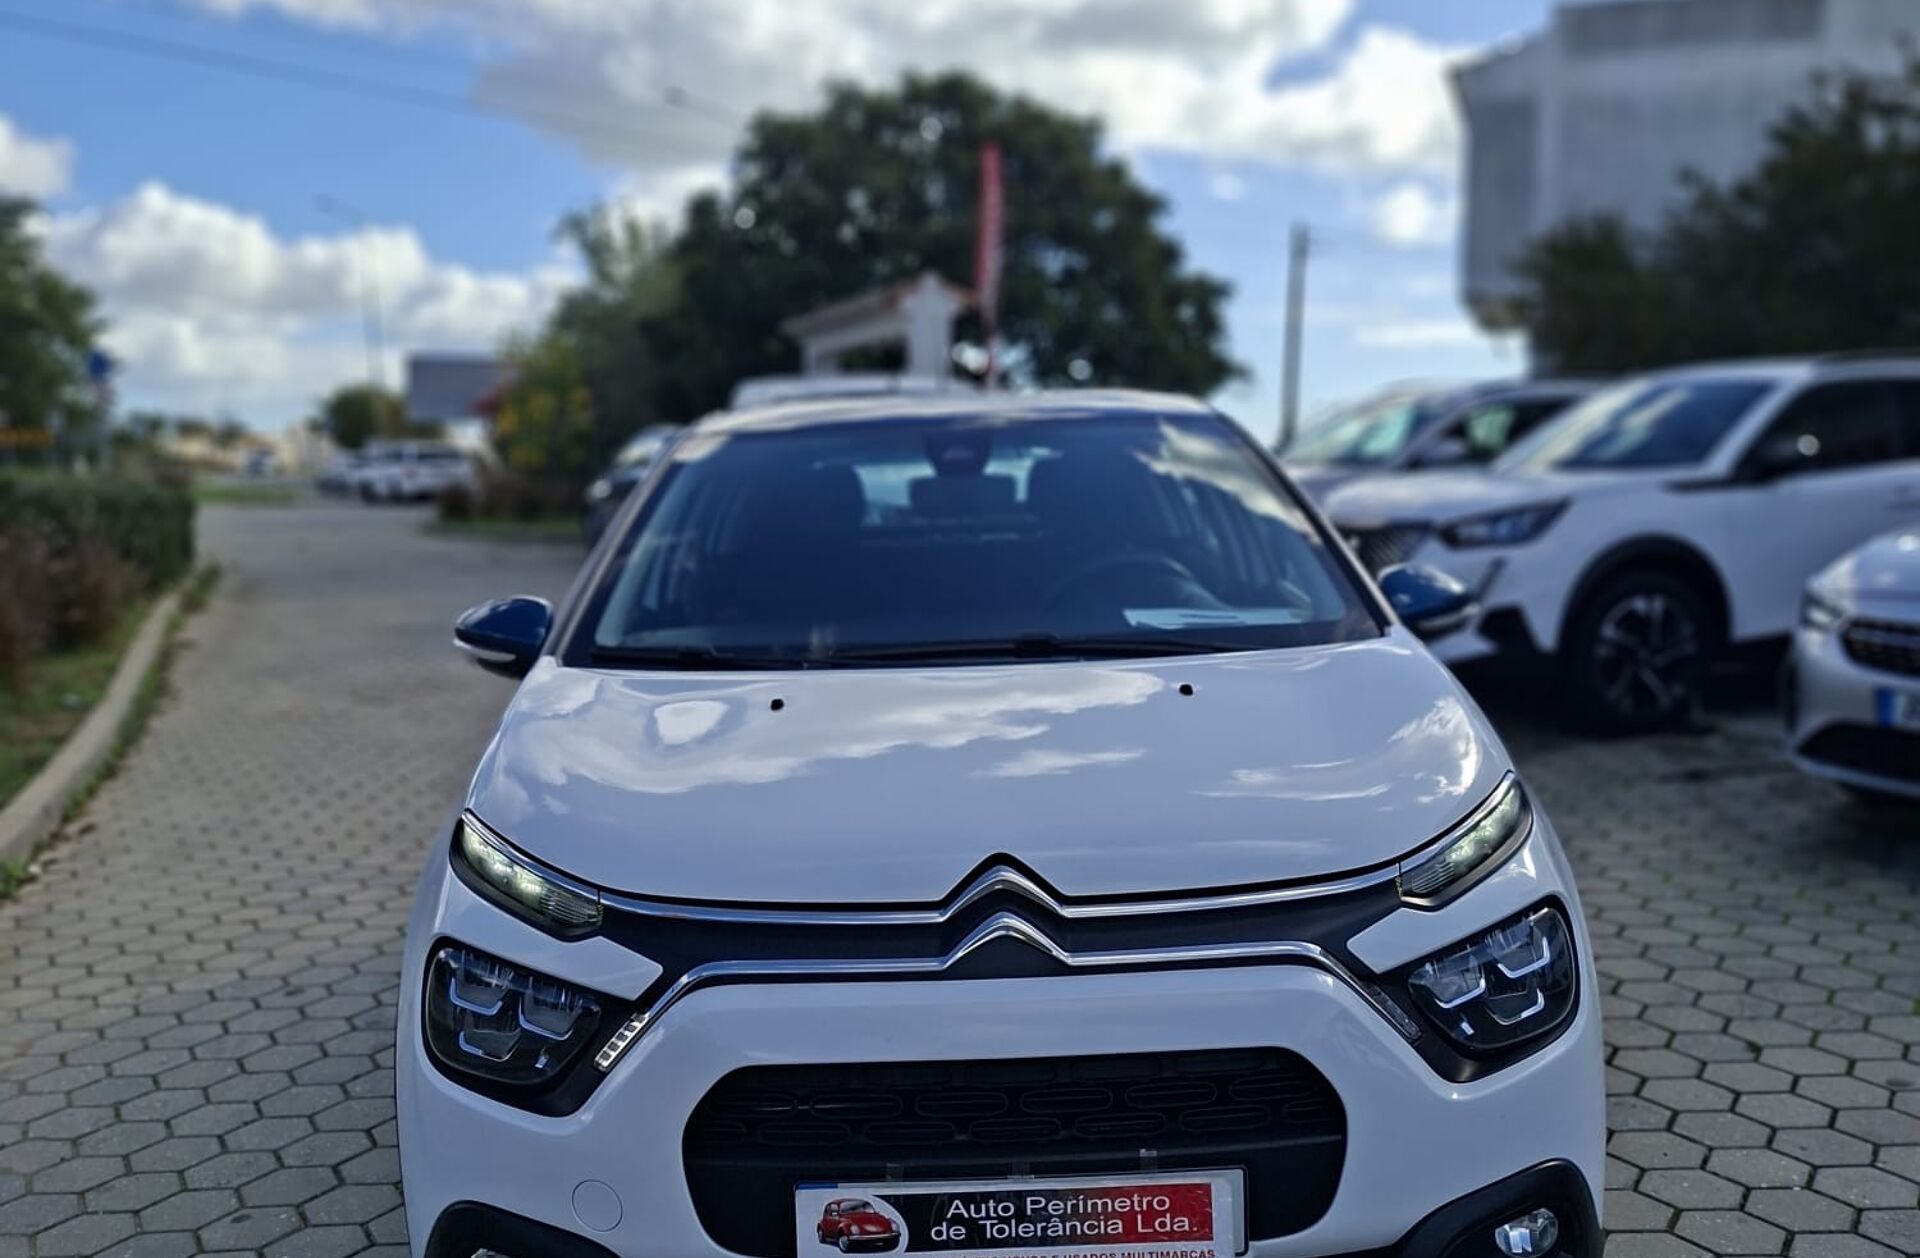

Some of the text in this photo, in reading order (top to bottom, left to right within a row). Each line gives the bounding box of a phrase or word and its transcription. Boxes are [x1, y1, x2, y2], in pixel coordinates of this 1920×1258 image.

[946, 1194, 1170, 1218] Auto Perímetro
[930, 1213, 1198, 1241] de Tolerância Lda.
[1121, 1249, 1215, 1258] MULTIMARCAS
